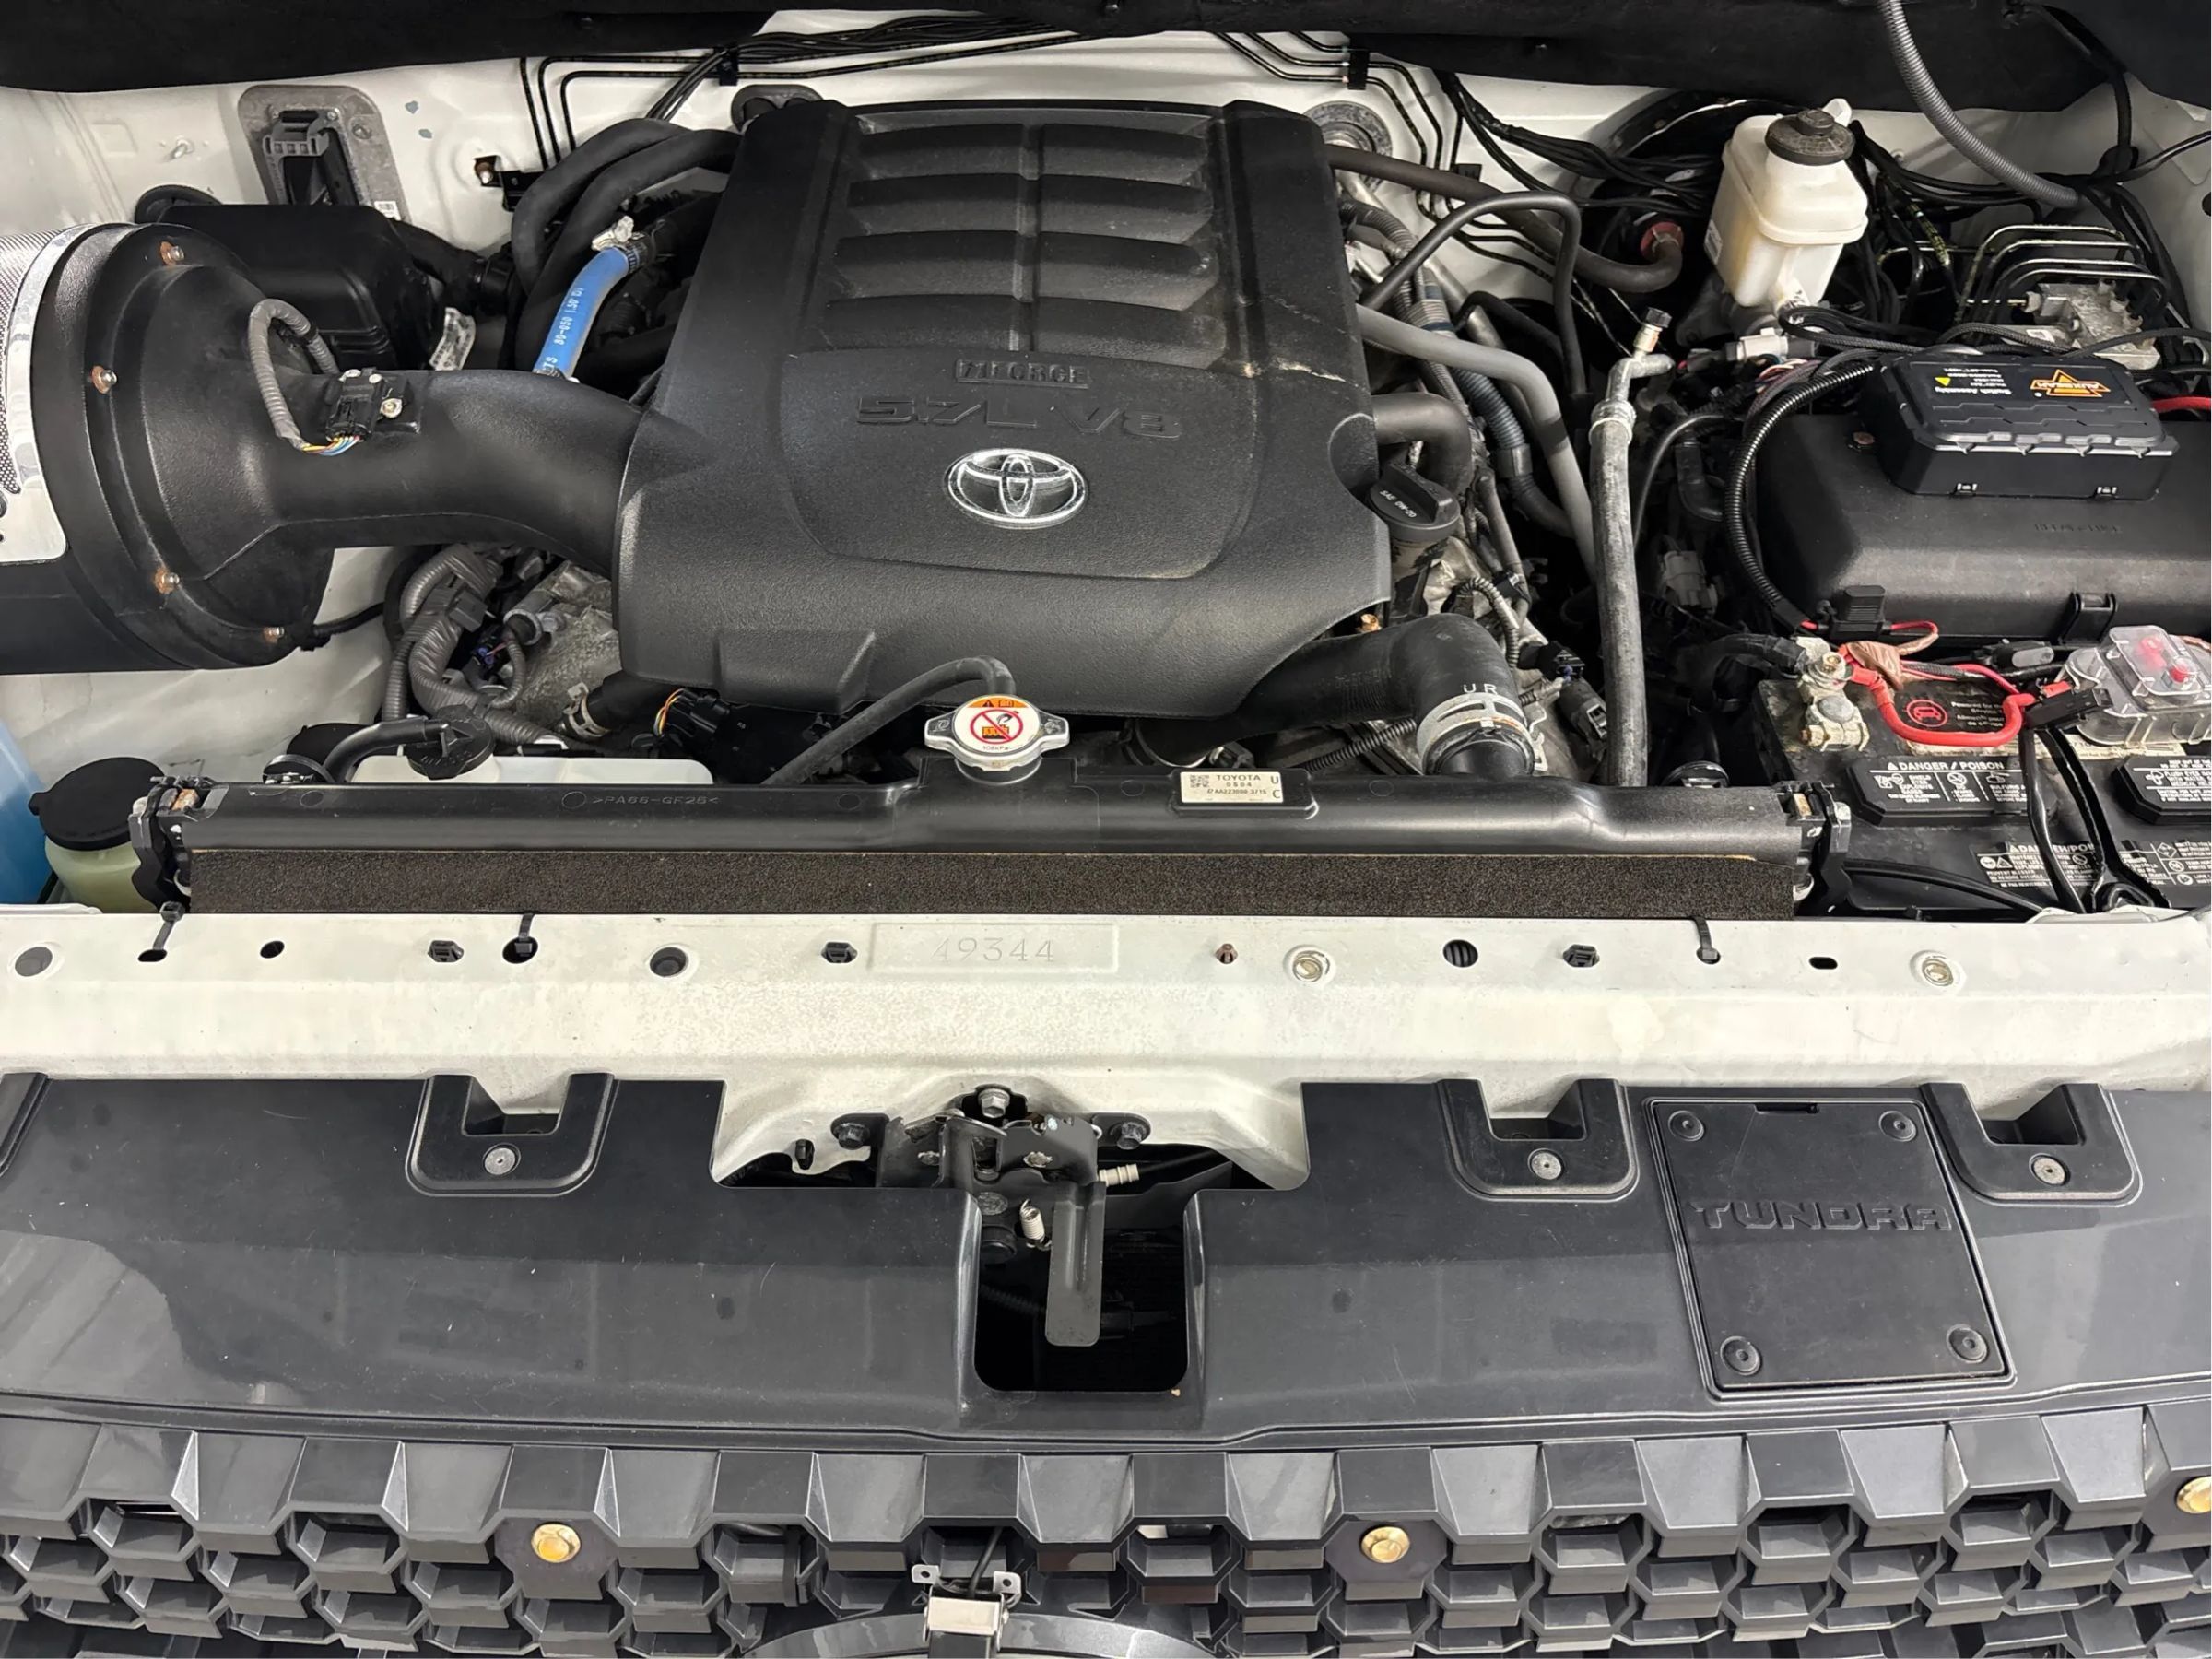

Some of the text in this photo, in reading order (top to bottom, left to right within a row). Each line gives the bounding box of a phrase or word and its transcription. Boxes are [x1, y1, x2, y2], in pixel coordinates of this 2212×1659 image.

[1379, 490, 1418, 518] SAE 0W-20
[1899, 761, 1948, 771] DANGER
[1960, 761, 2005, 771] POISON
[931, 936, 1055, 962] 49344
[1688, 1201, 1952, 1230] TUNDRA
